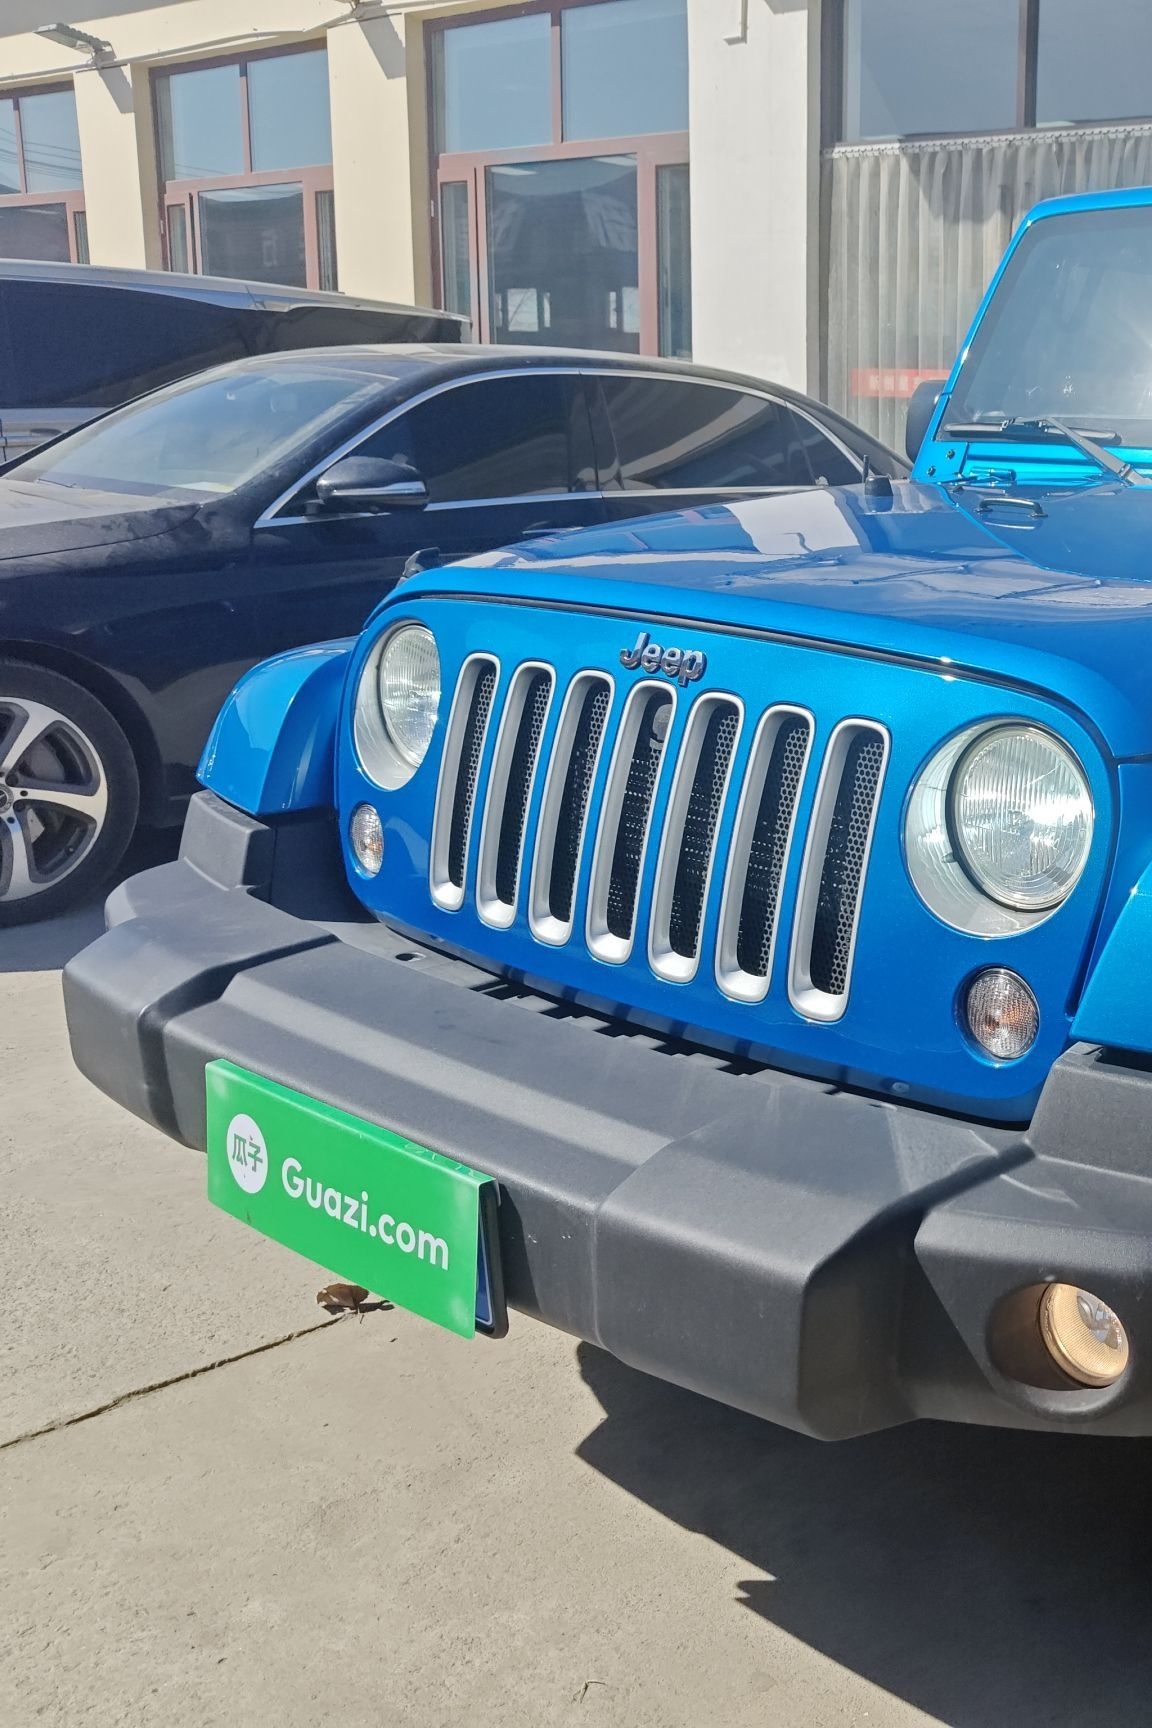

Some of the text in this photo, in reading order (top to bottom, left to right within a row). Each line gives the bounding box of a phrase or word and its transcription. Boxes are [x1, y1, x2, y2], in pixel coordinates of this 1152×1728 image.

[620, 632, 707, 688] Jeep
[231, 1133, 264, 1172] 瓜子
[281, 1156, 449, 1271] Guazi.com
